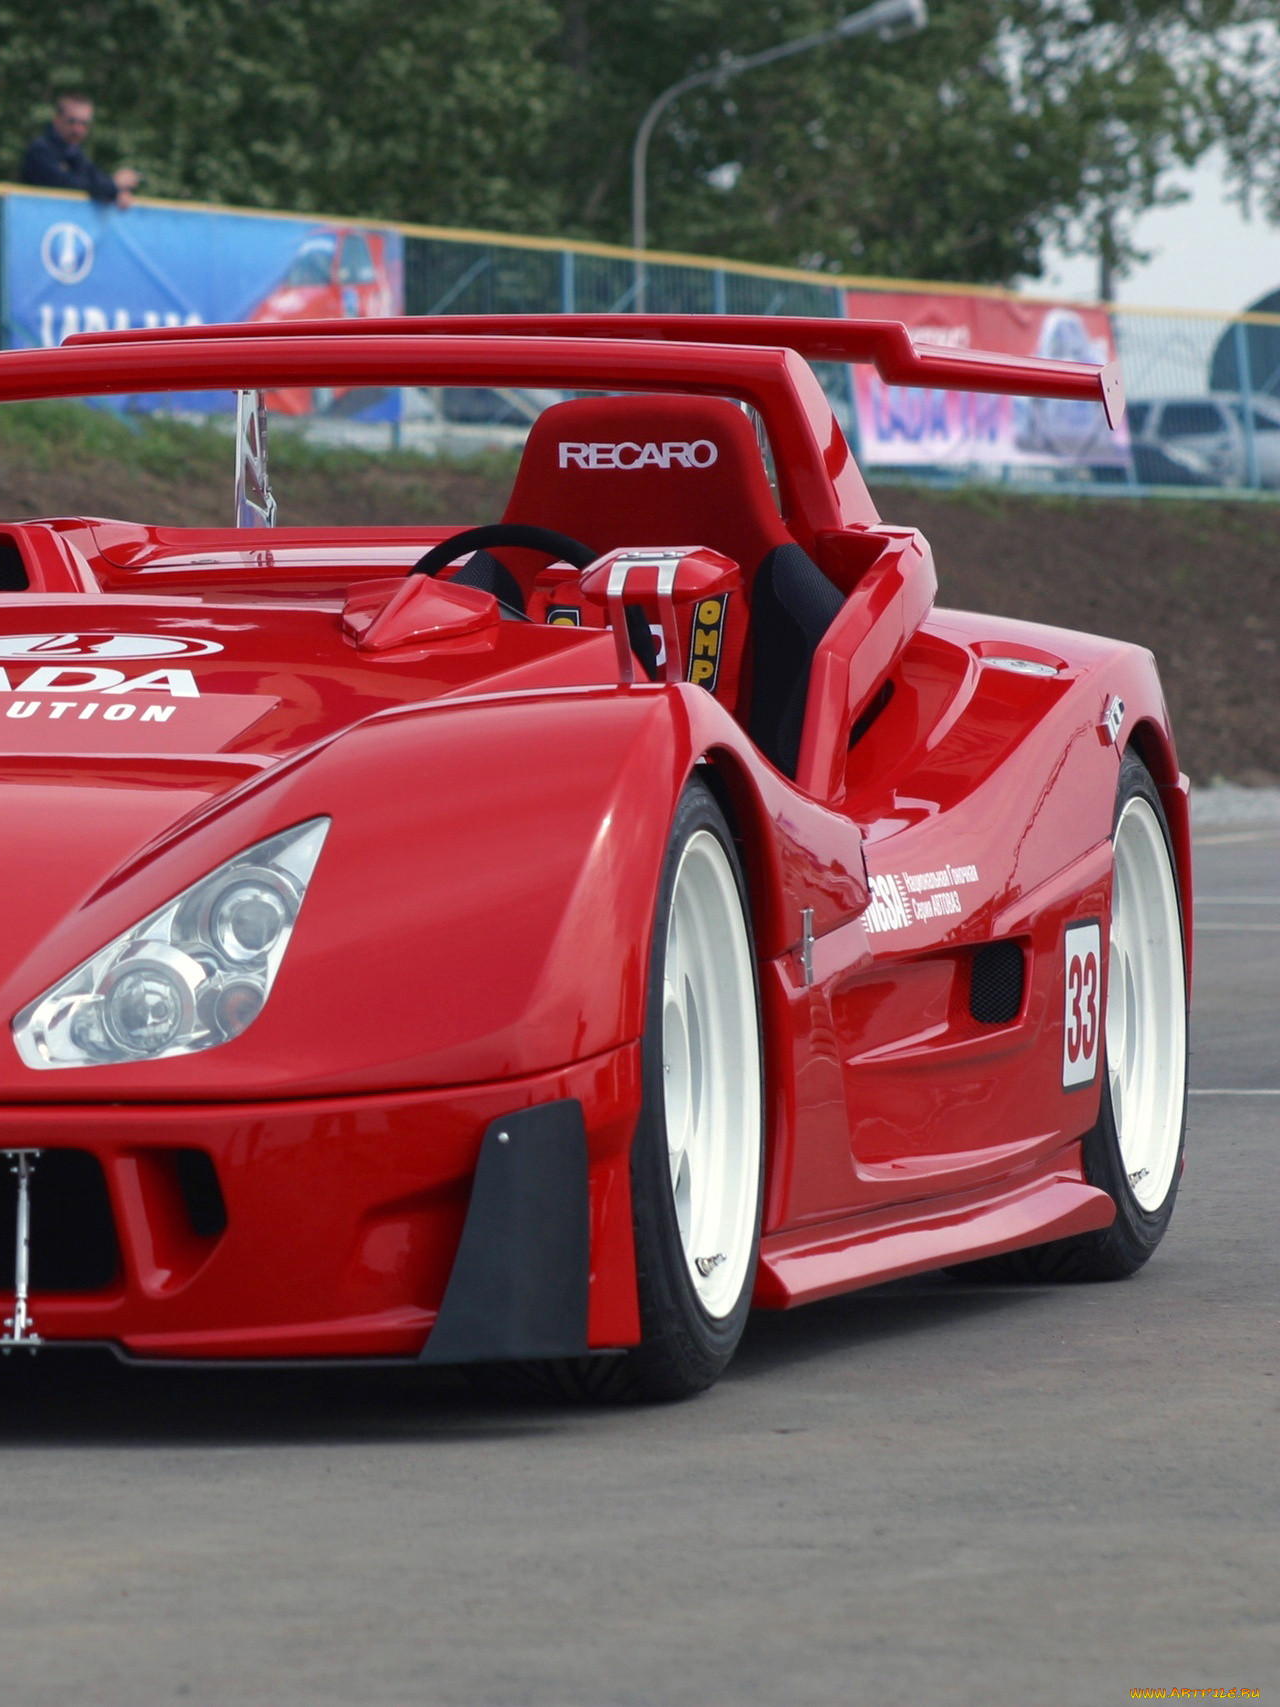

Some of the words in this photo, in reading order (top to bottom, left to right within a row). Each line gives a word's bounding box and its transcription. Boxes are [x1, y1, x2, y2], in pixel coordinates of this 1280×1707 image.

[558, 439, 718, 470] RECARO
[691, 600, 721, 684] OMP
[1068, 952, 1097, 1063] 33
